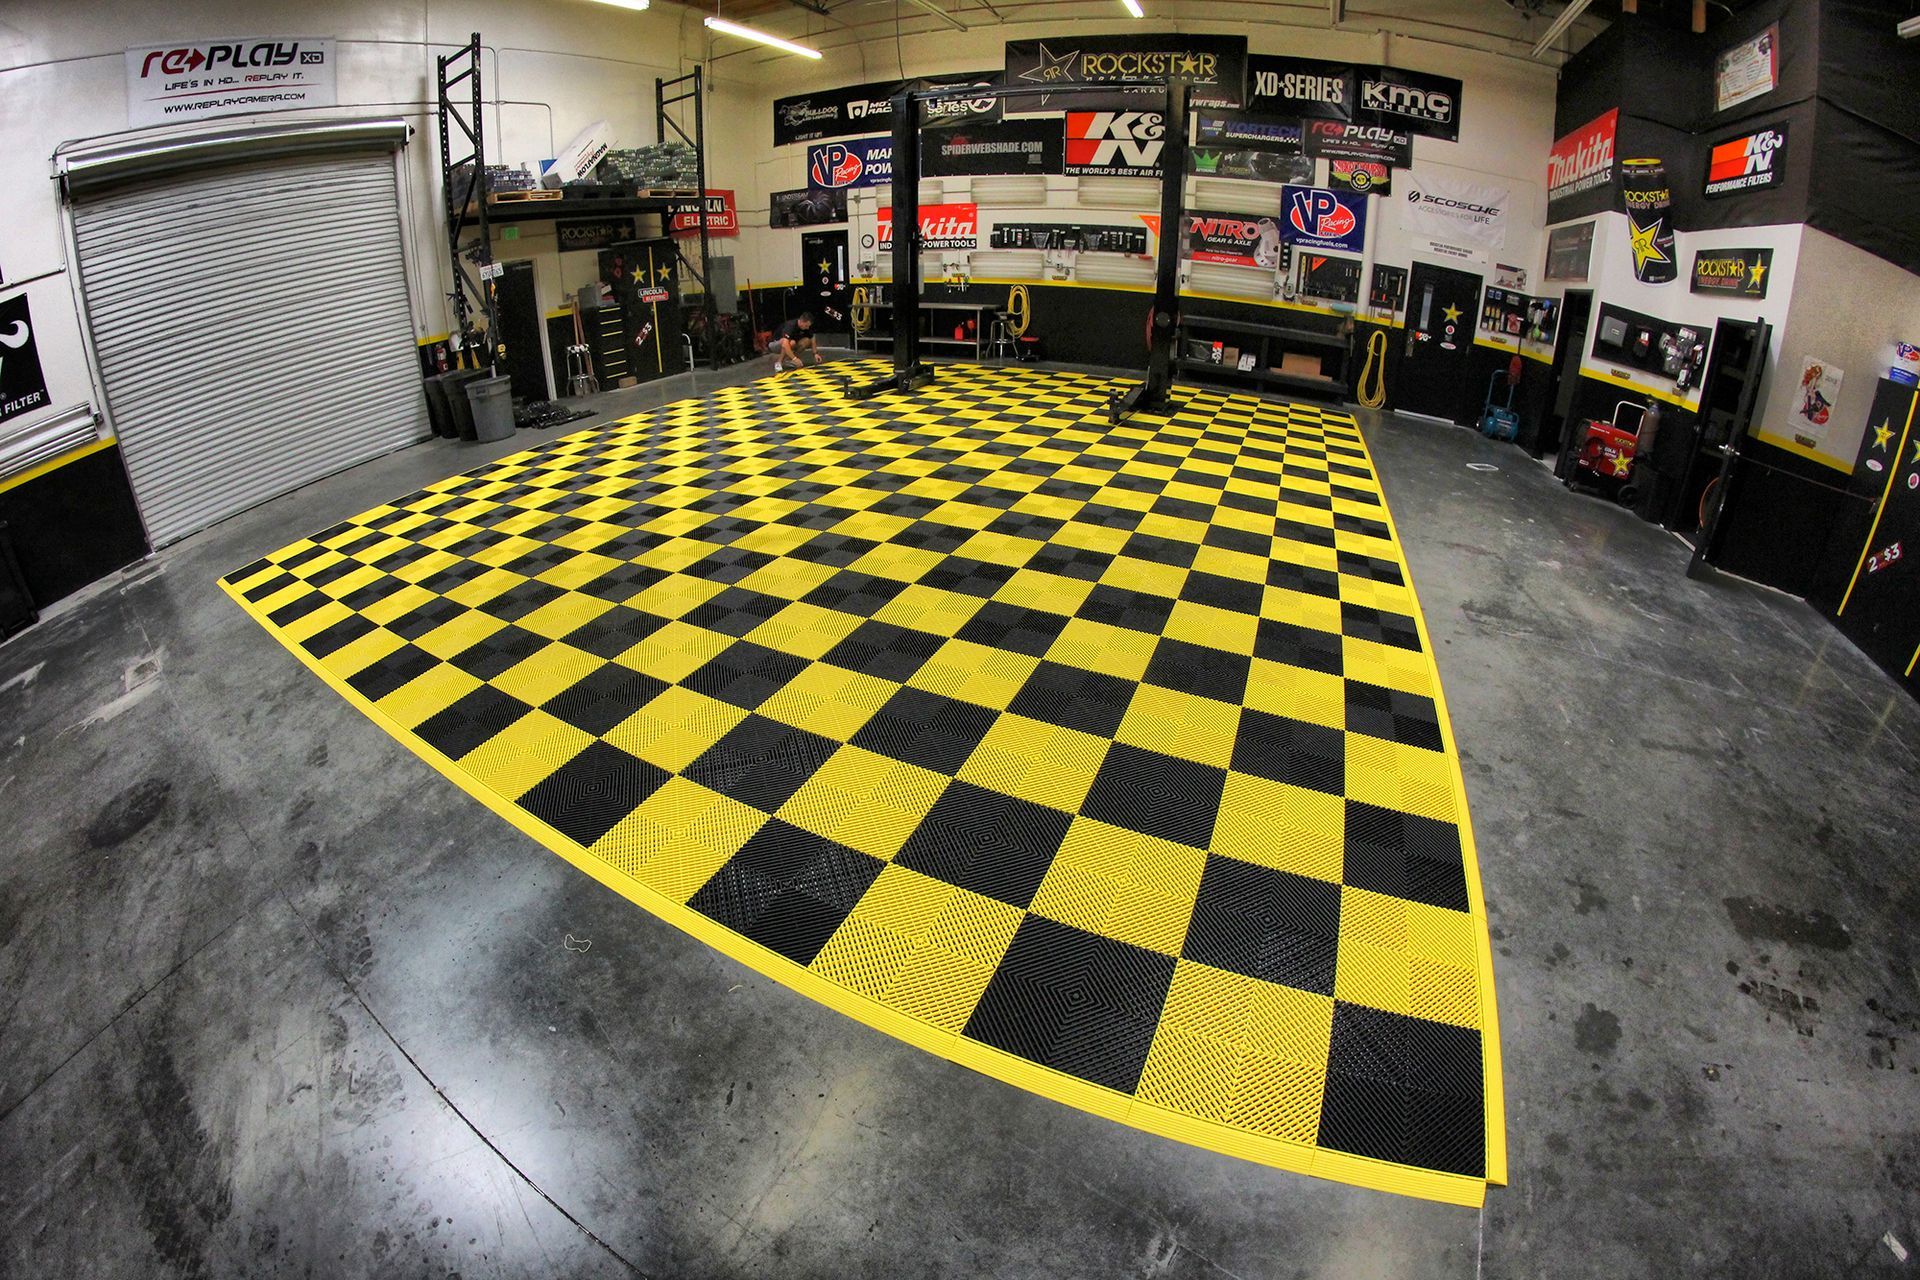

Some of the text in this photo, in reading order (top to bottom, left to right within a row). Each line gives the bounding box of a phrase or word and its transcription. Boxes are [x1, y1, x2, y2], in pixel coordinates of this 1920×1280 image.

[164, 80, 199, 91] LIFE'S
[244, 73, 288, 82] REPLAY
[1284, 73, 1343, 103] SERIES
[164, 93, 306, 114] WWW.REPLAYCAMERA.COM
[1367, 100, 1445, 120] WHEELS
[1225, 132, 1284, 142] SUPERCHARGERS
[941, 141, 1043, 155] SPIDERWEBSHADE.COM
[1082, 167, 1116, 175] WORLD'S
[1117, 168, 1138, 176] BEST
[1705, 172, 1773, 194] PERFORMANCE FILTERS
[1423, 194, 1500, 216] SCOSCHE
[1190, 216, 1261, 241] NITRO
[1321, 217, 1354, 231] Racing
[1473, 216, 1490, 225] LIFE
[950, 239, 976, 248] TOOLS
[1296, 238, 1348, 249] vpracingfuels.com
[4, 391, 41, 414] FILTER
[1869, 542, 1901, 573] 2 $3
